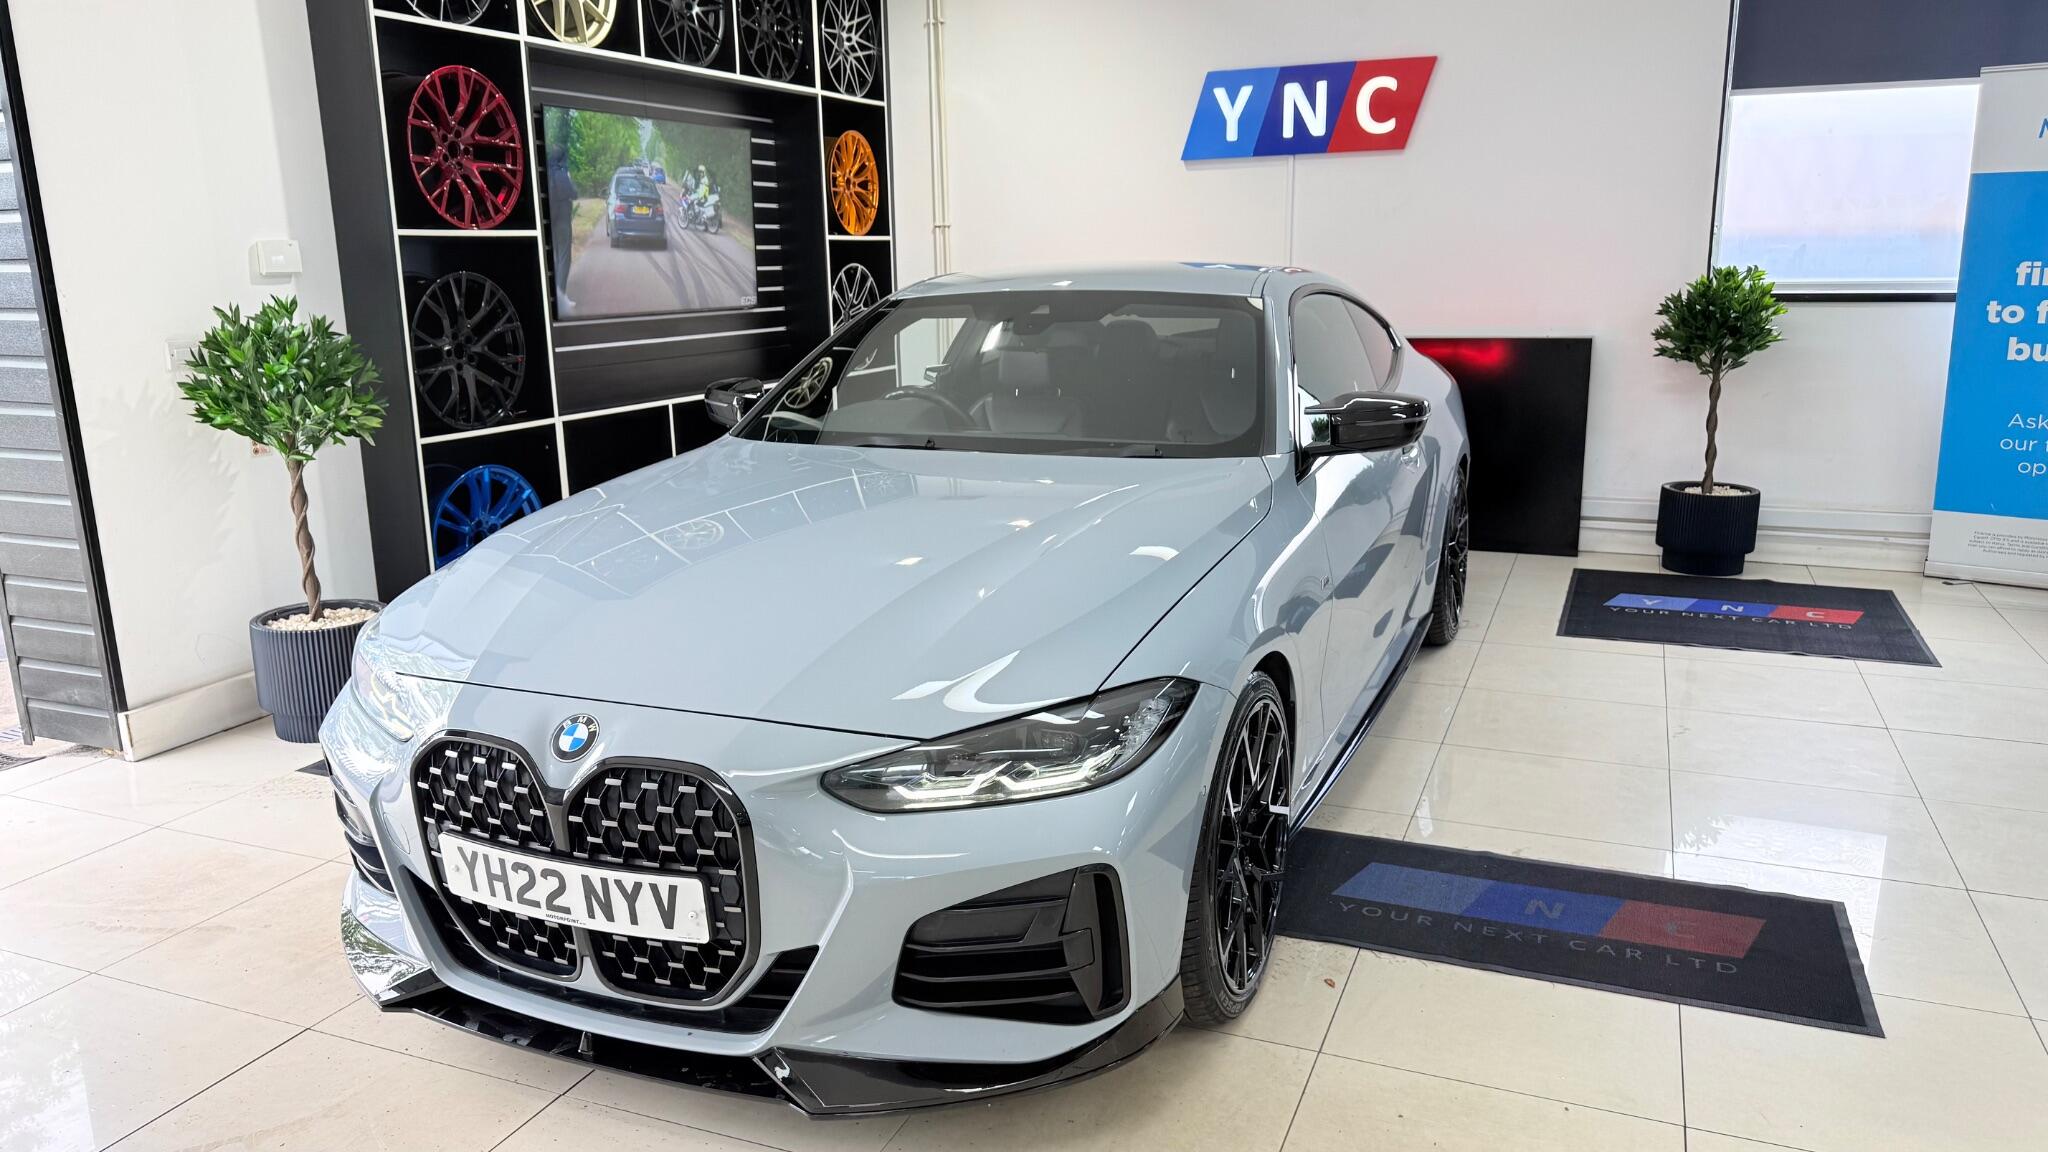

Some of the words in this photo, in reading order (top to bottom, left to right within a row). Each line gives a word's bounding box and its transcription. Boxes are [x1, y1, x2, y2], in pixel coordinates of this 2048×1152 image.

[1213, 75, 1398, 142] YNC
[1986, 300, 2025, 324] to
[2008, 413, 2048, 430] Ask
[2000, 438, 2038, 451] our
[457, 846, 571, 915] YH22
[581, 874, 678, 930] NYV
[1339, 902, 1433, 926] YOUR
[1453, 921, 1548, 944] NEXT
[1568, 940, 1643, 960] CAR
[1665, 953, 1737, 974] LTD
